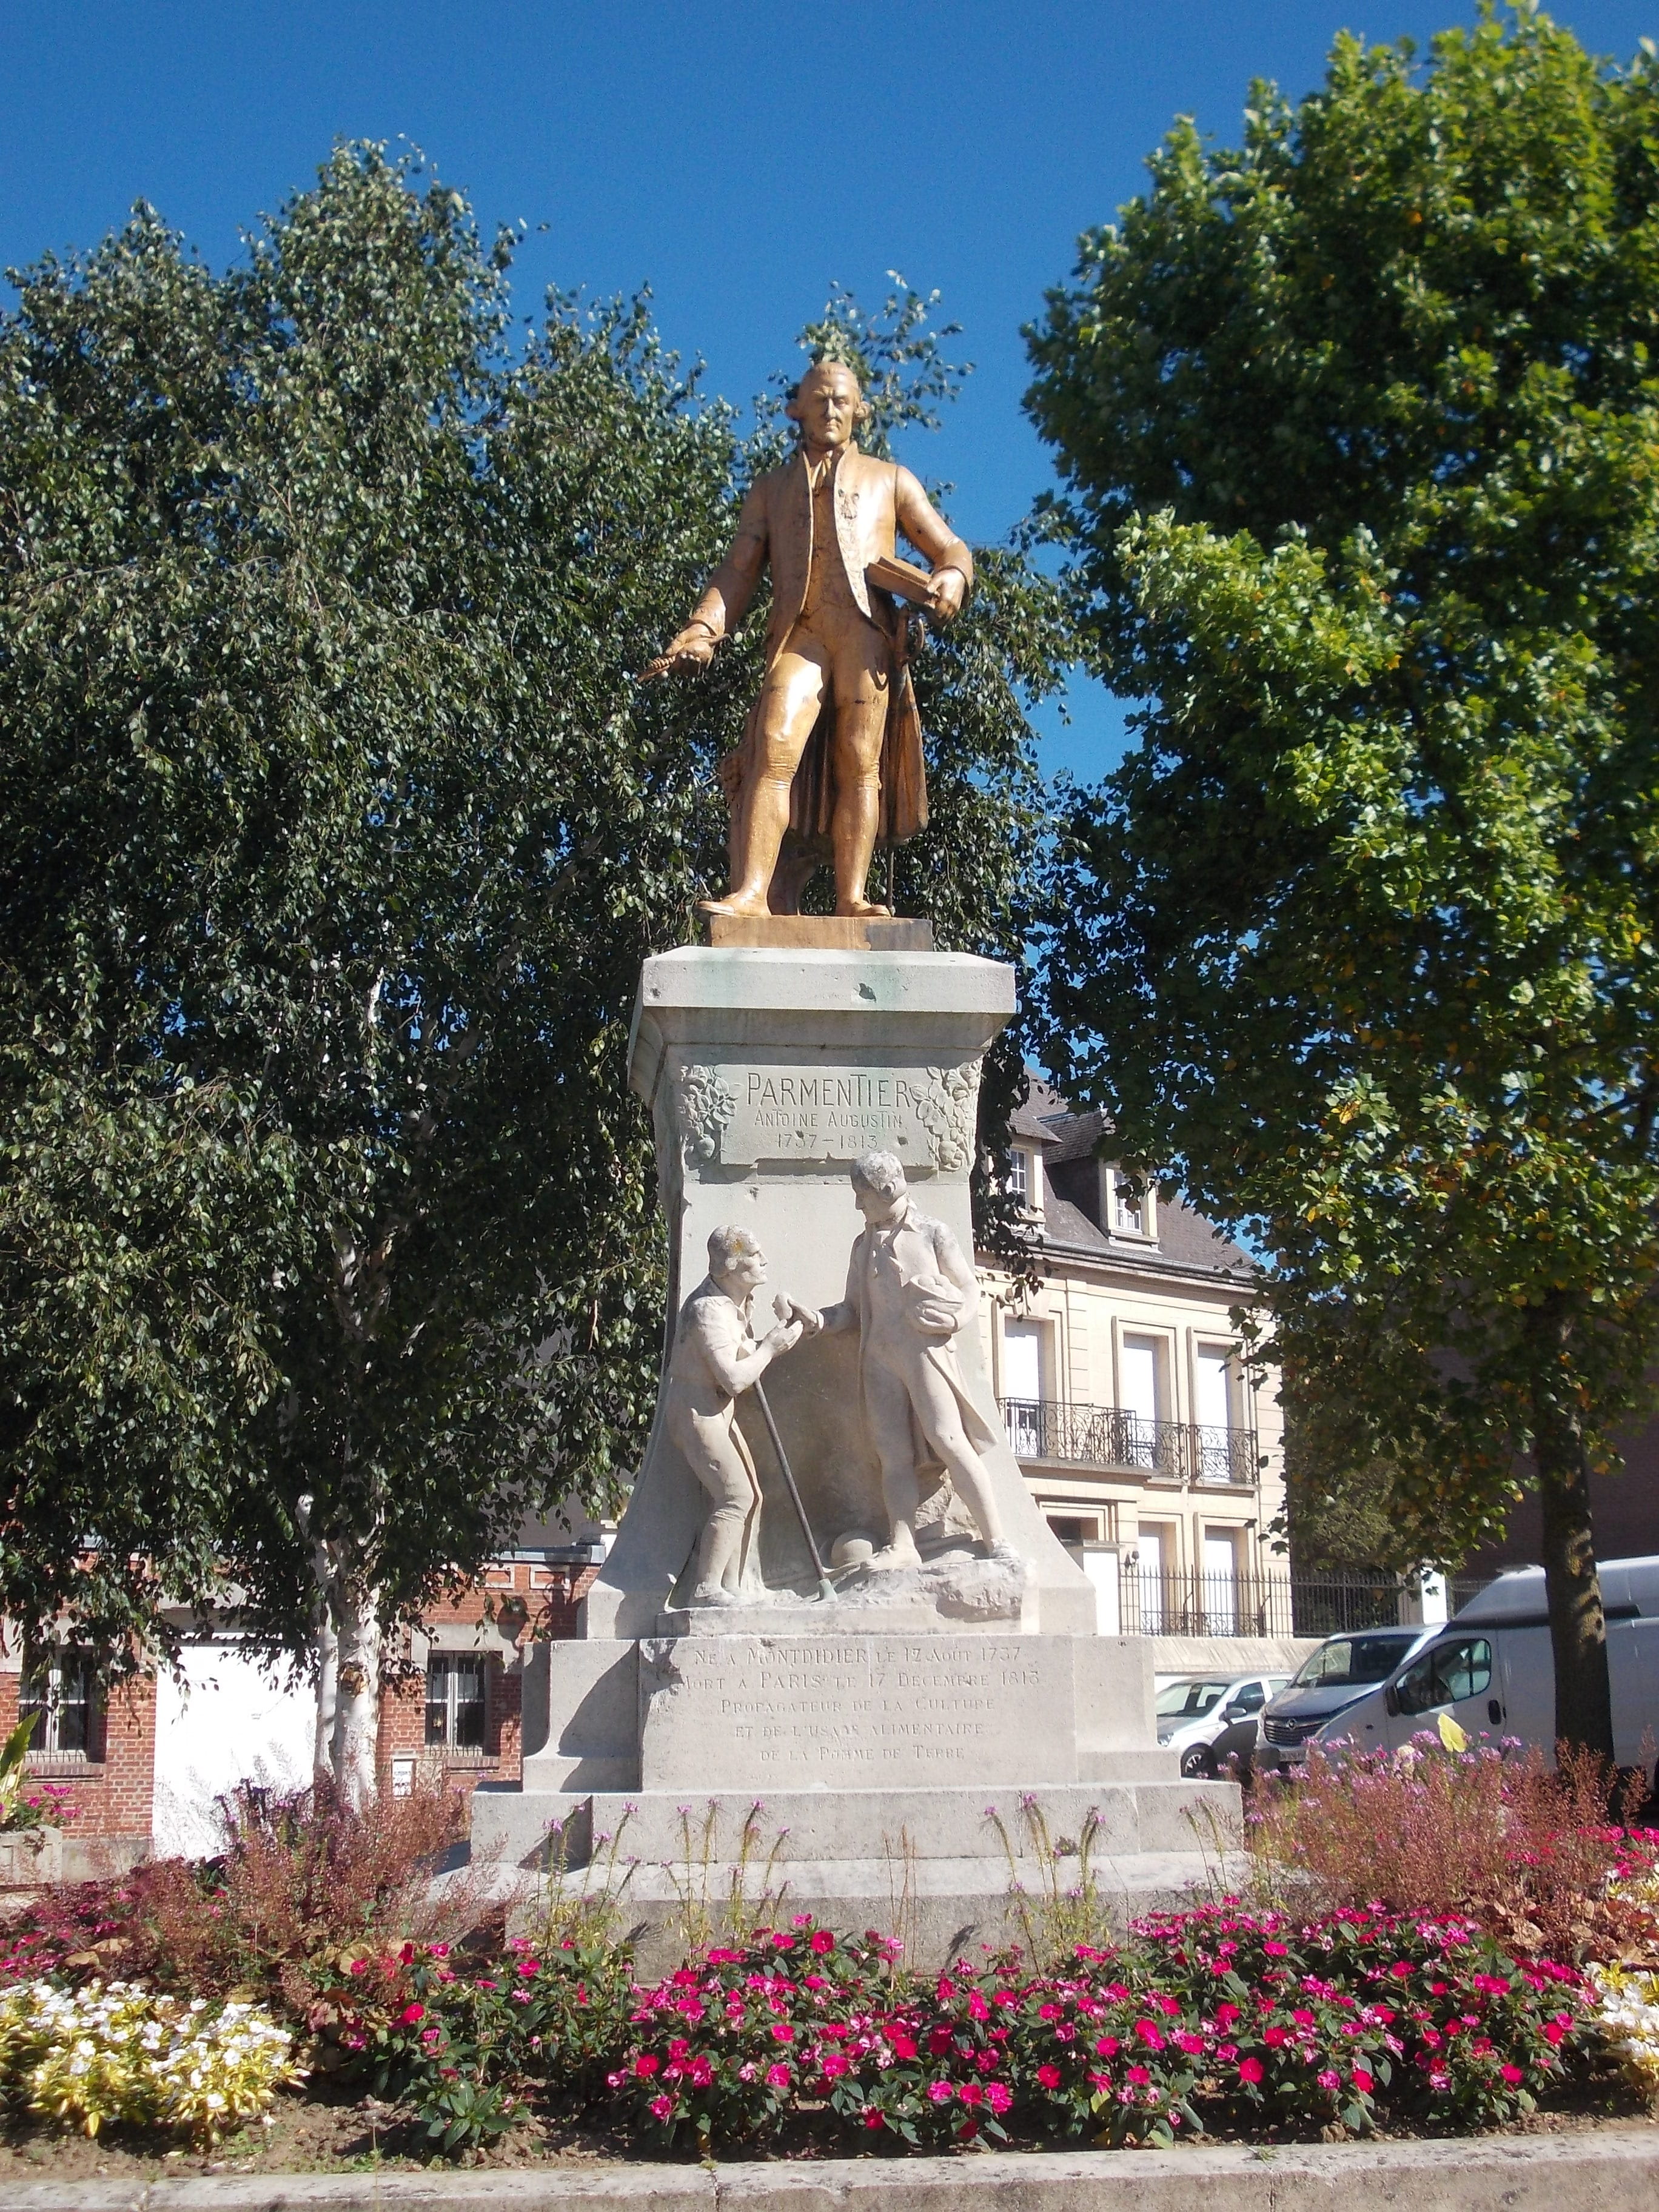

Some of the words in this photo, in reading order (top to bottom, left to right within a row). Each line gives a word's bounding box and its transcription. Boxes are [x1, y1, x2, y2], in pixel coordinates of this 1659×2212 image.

[746, 1072, 911, 1107] PARMENTIER
[755, 1109, 818, 1127] ANTOINE
[761, 1672, 821, 1689] PARIS
[853, 1701, 871, 1711] DE
[883, 1700, 902, 1712] LA
